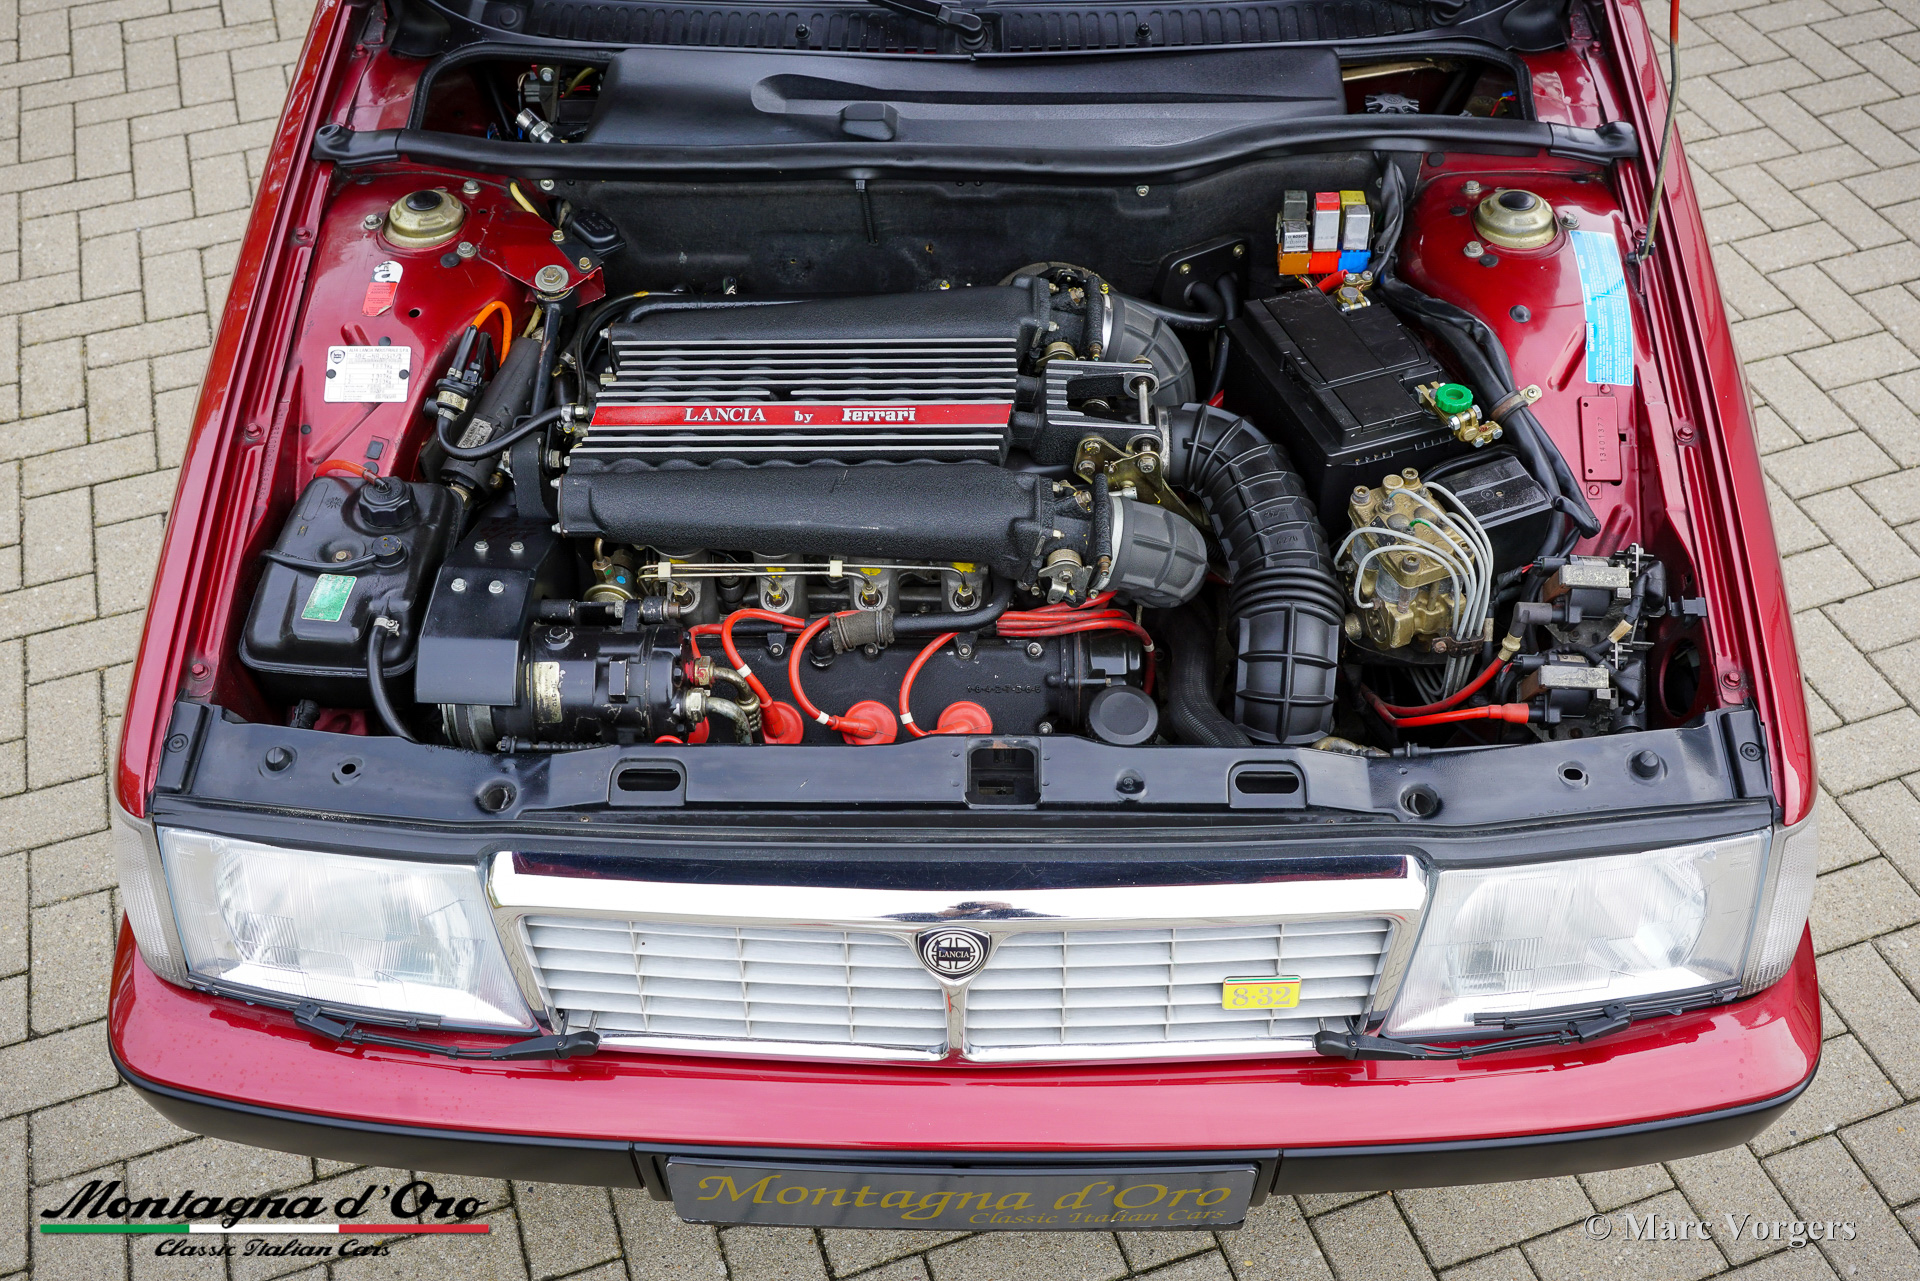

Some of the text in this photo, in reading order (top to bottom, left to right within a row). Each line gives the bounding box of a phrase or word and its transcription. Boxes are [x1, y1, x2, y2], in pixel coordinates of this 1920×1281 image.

[684, 408, 916, 424] LANCIA by Ferrari
[1597, 416, 1606, 462] 13401377
[938, 950, 970, 958] LANCIA
[697, 1175, 1232, 1221] Montagna d'Oro
[969, 1206, 1227, 1226] Classic Italian Cars
